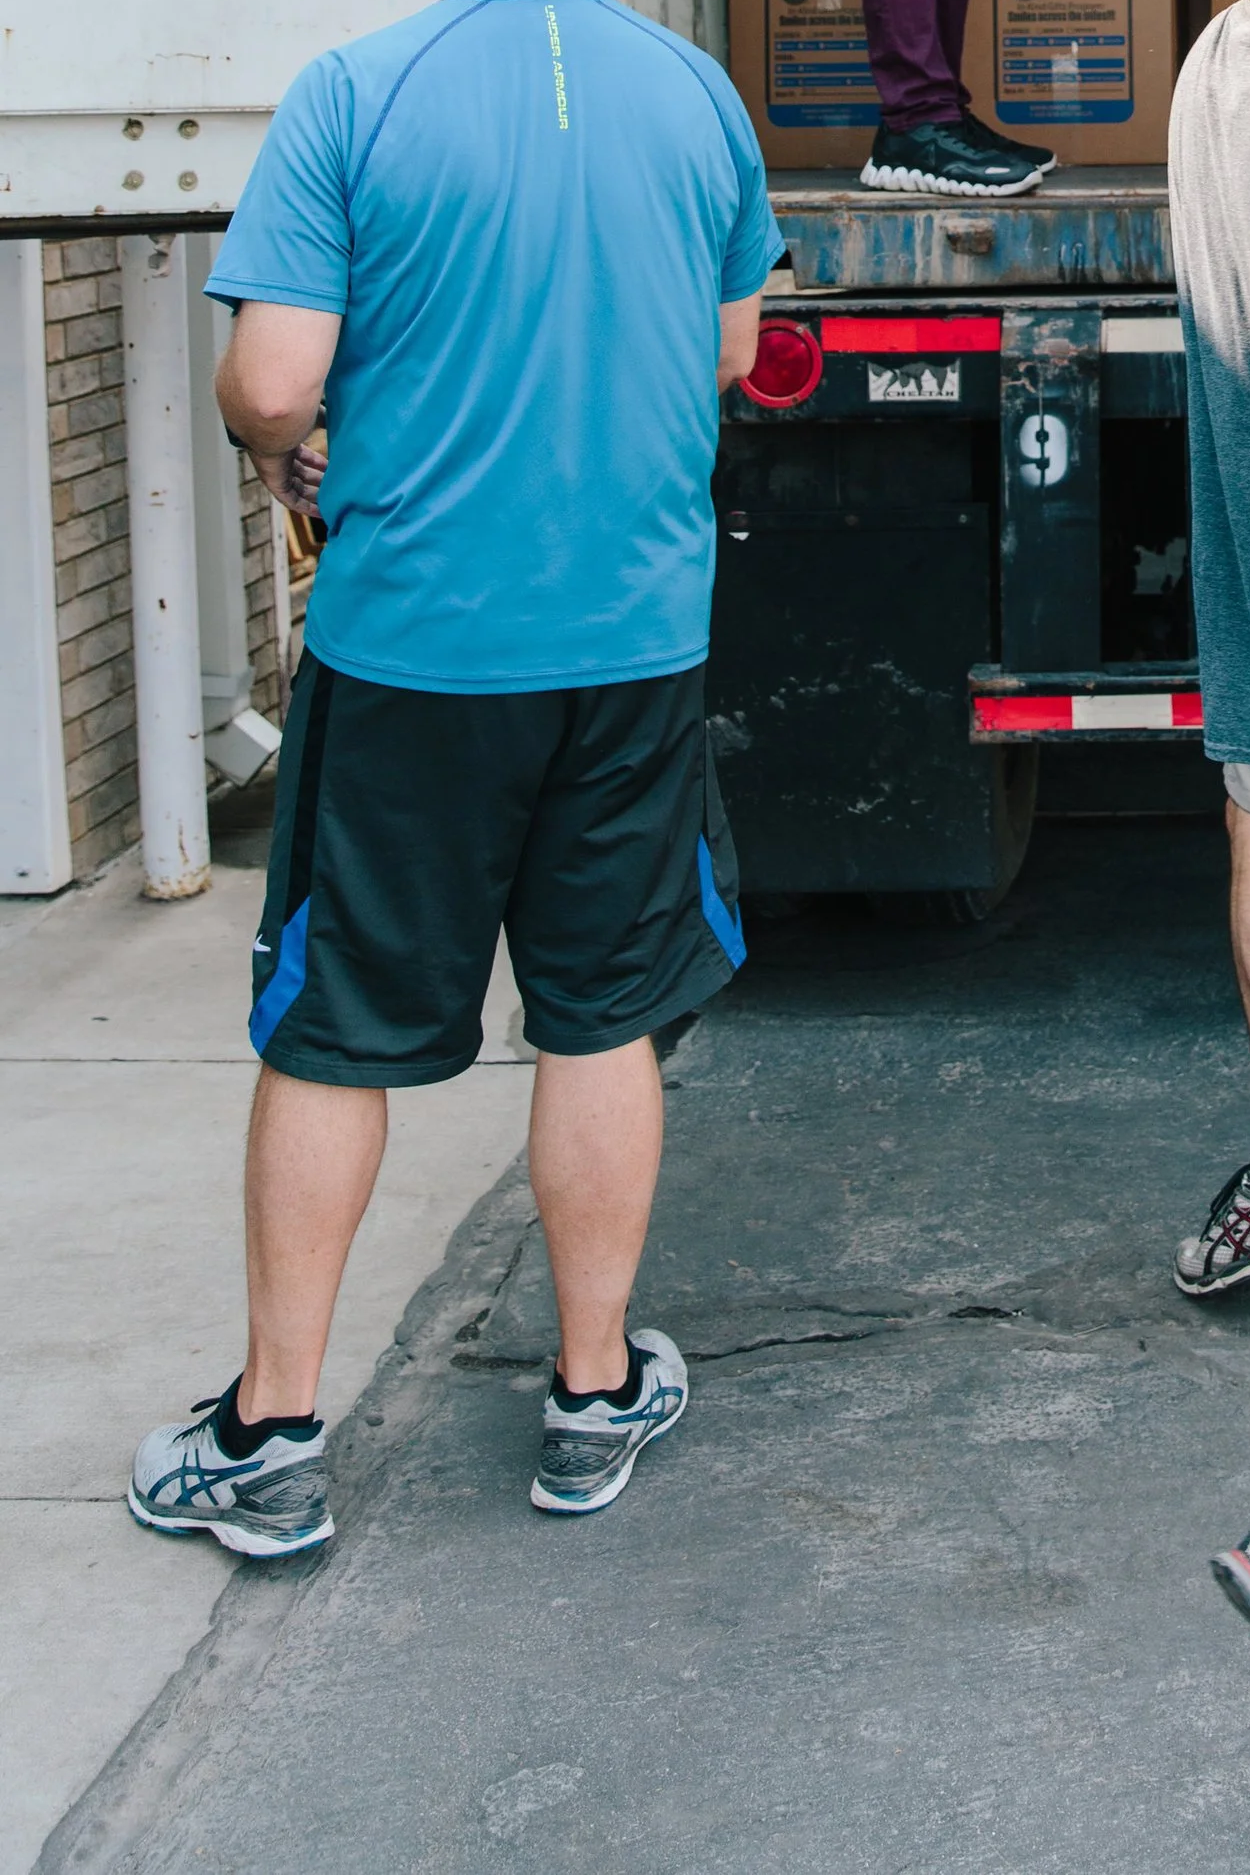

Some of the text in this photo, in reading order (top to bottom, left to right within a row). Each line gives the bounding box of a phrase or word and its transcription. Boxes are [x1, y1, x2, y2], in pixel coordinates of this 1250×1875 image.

[544, 4, 569, 130] UNDER ARMOUR
[886, 390, 955, 398] CHEETAH
[1019, 413, 1069, 488] 9
